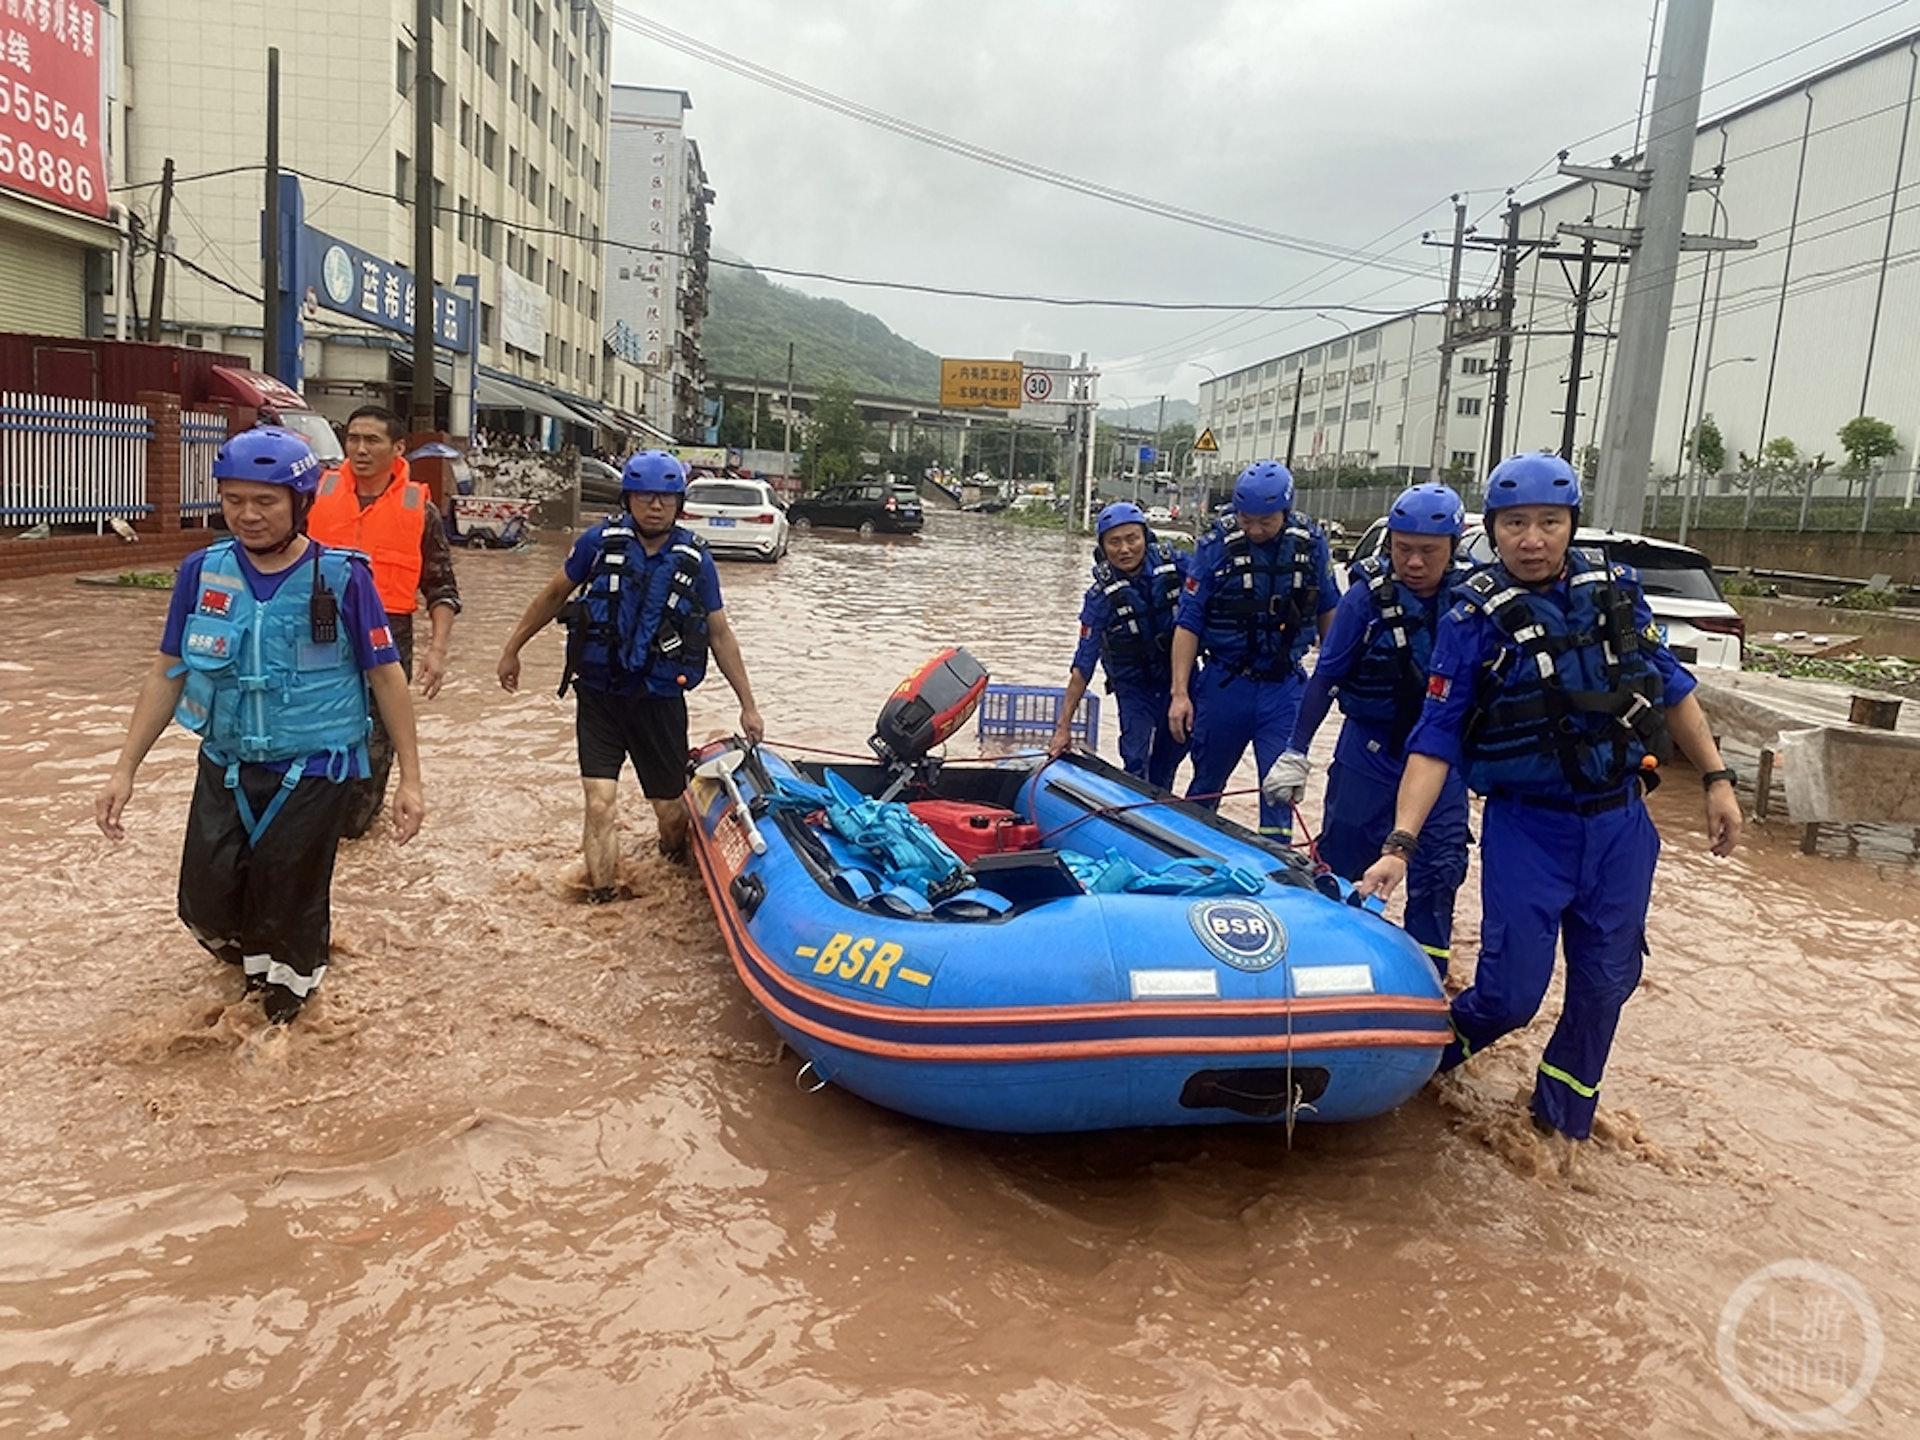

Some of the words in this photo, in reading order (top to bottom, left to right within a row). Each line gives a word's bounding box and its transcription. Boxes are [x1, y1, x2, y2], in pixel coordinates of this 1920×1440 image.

[0, 29, 32, 74] 线
[0, 133, 94, 202] 58886
[1029, 378, 1047, 394] 30
[1211, 916, 1267, 935] BSR
